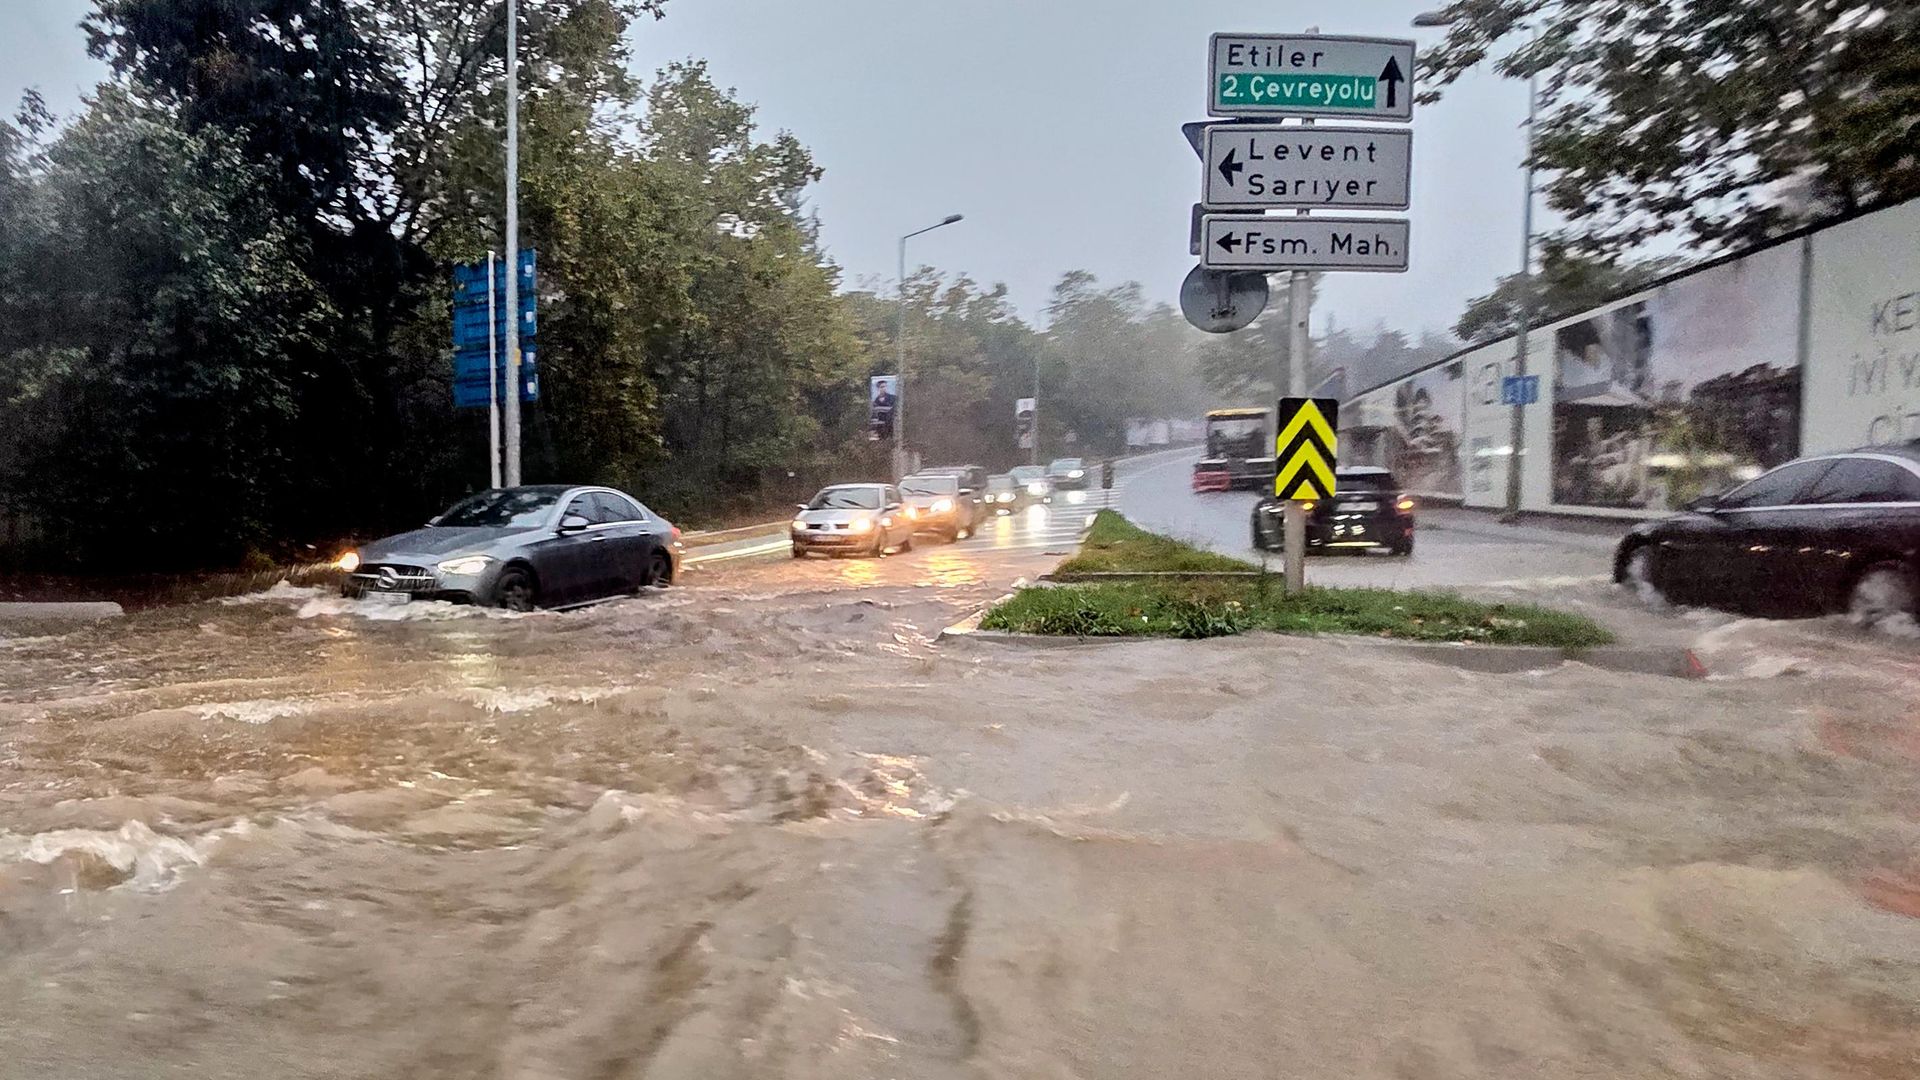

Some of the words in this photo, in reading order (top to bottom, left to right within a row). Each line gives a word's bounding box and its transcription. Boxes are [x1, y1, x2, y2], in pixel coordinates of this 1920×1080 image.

[1227, 43, 1325, 68] Etiler
[1222, 76, 1244, 98] 2.
[1250, 76, 1374, 104] Çevreyolu
[1249, 138, 1376, 163] Levent
[1248, 173, 1377, 203] Sarıyer
[1245, 232, 1317, 254] Fsm.
[1330, 232, 1398, 256] Mah.
[1870, 291, 1920, 337] KE
